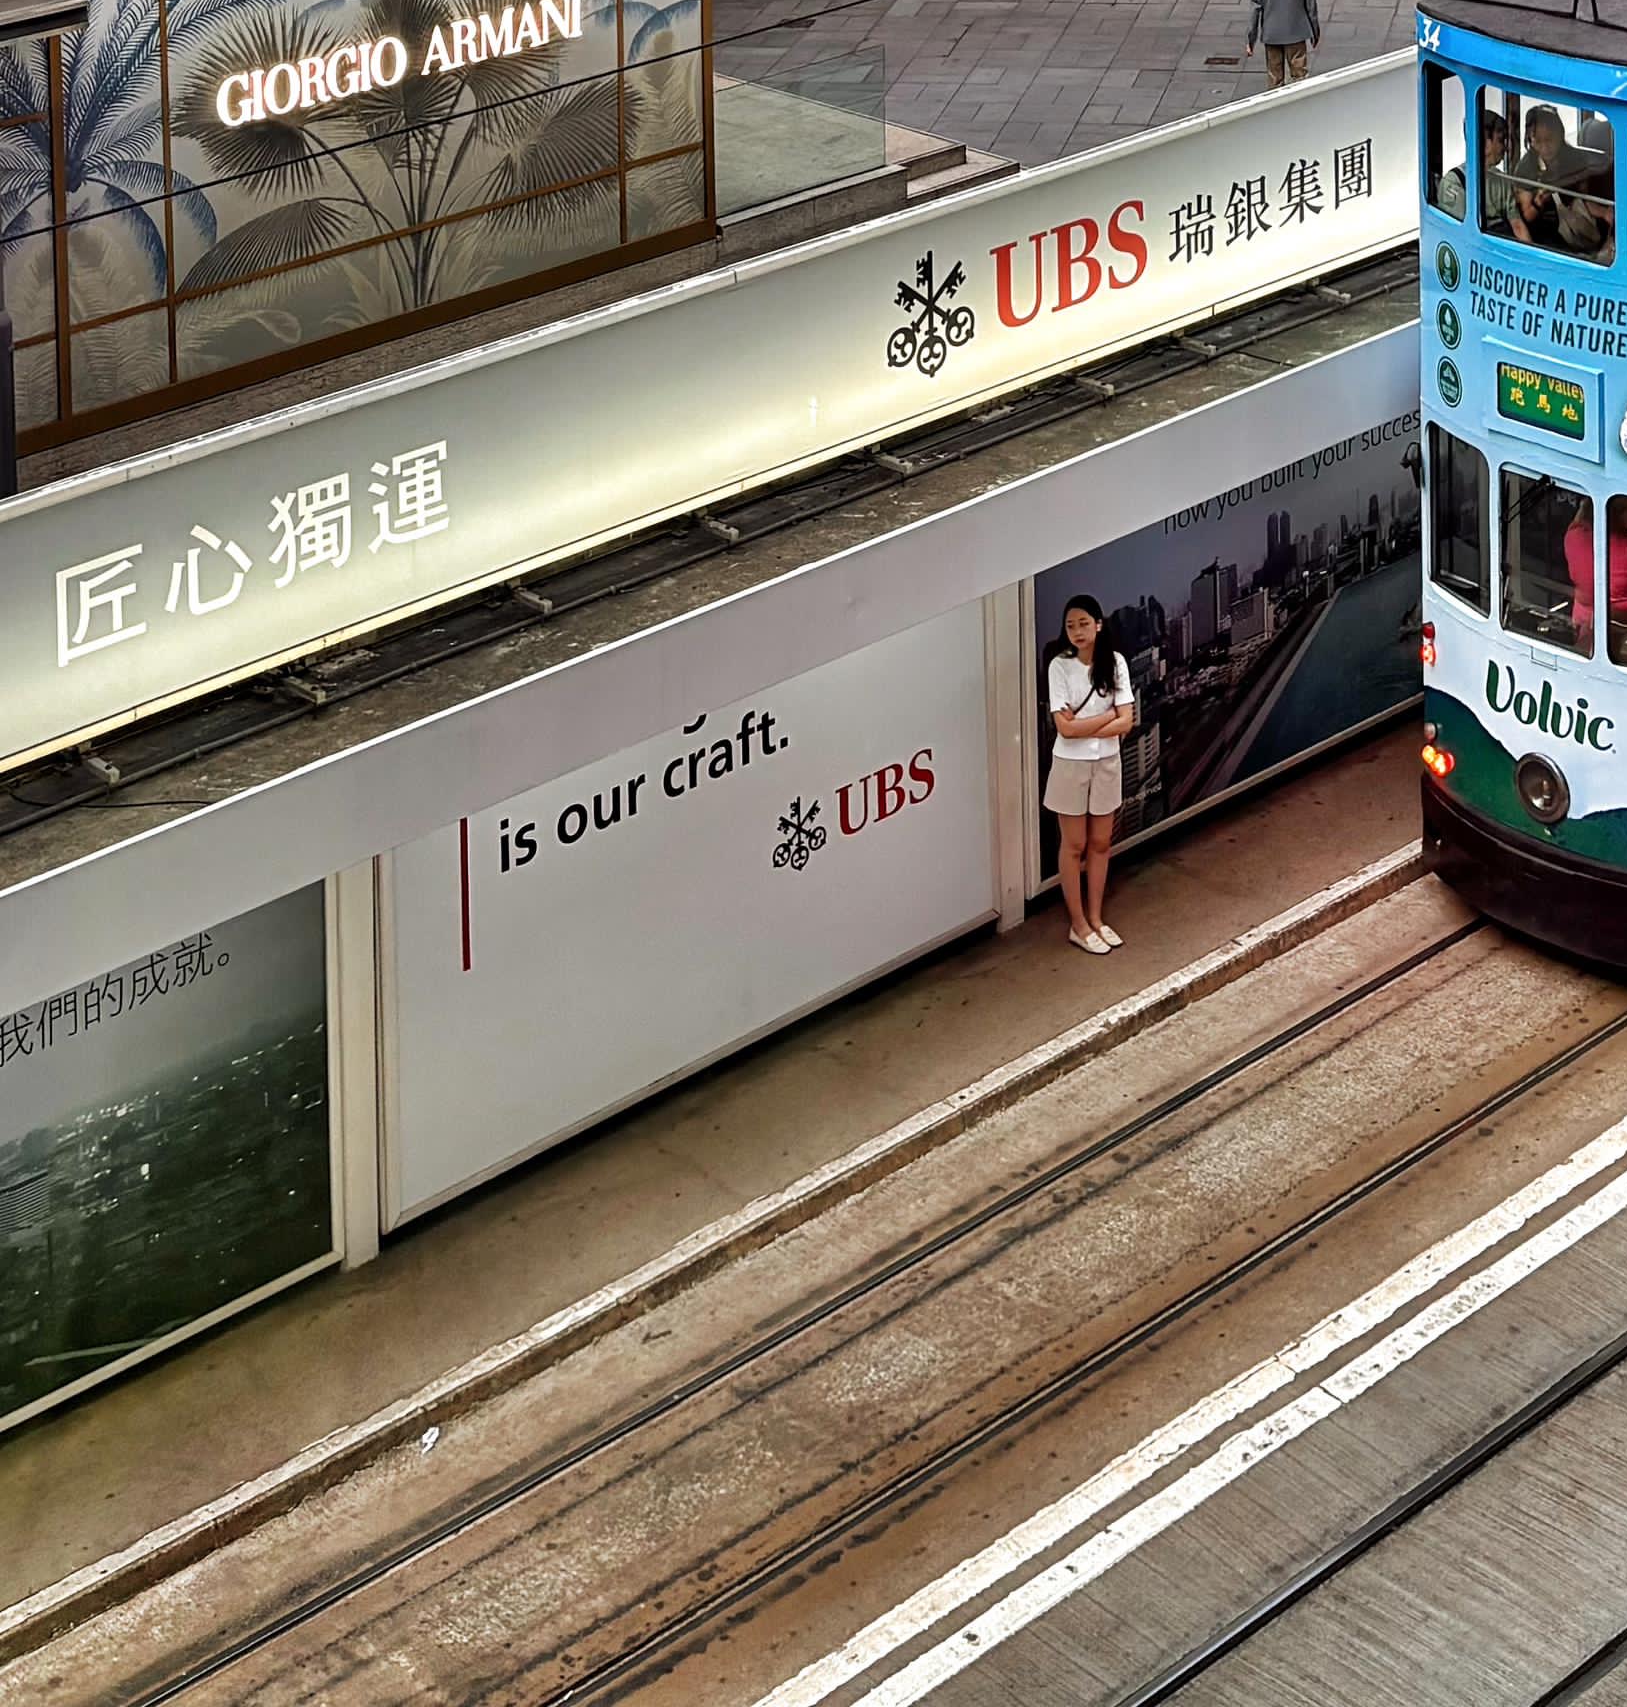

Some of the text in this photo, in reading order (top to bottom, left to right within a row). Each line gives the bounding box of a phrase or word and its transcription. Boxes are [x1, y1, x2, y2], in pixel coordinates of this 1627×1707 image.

[215, 35, 408, 129] GIORGIO
[1419, 19, 1441, 52] 34
[989, 138, 1374, 328] UBS 瑞銀集團
[1469, 259, 1548, 309] DISCOVER
[1554, 289, 1566, 314] A
[1470, 290, 1516, 330] TASTE
[1522, 309, 1545, 337] OF
[1215, 481, 1254, 521] you
[1312, 435, 1356, 479] your
[1360, 409, 1421, 451] succes
[55, 440, 450, 668] 匠心獨運
[1486, 660, 1615, 752] Volvic
[500, 710, 789, 873] is our craft.
[836, 747, 936, 836] UBS
